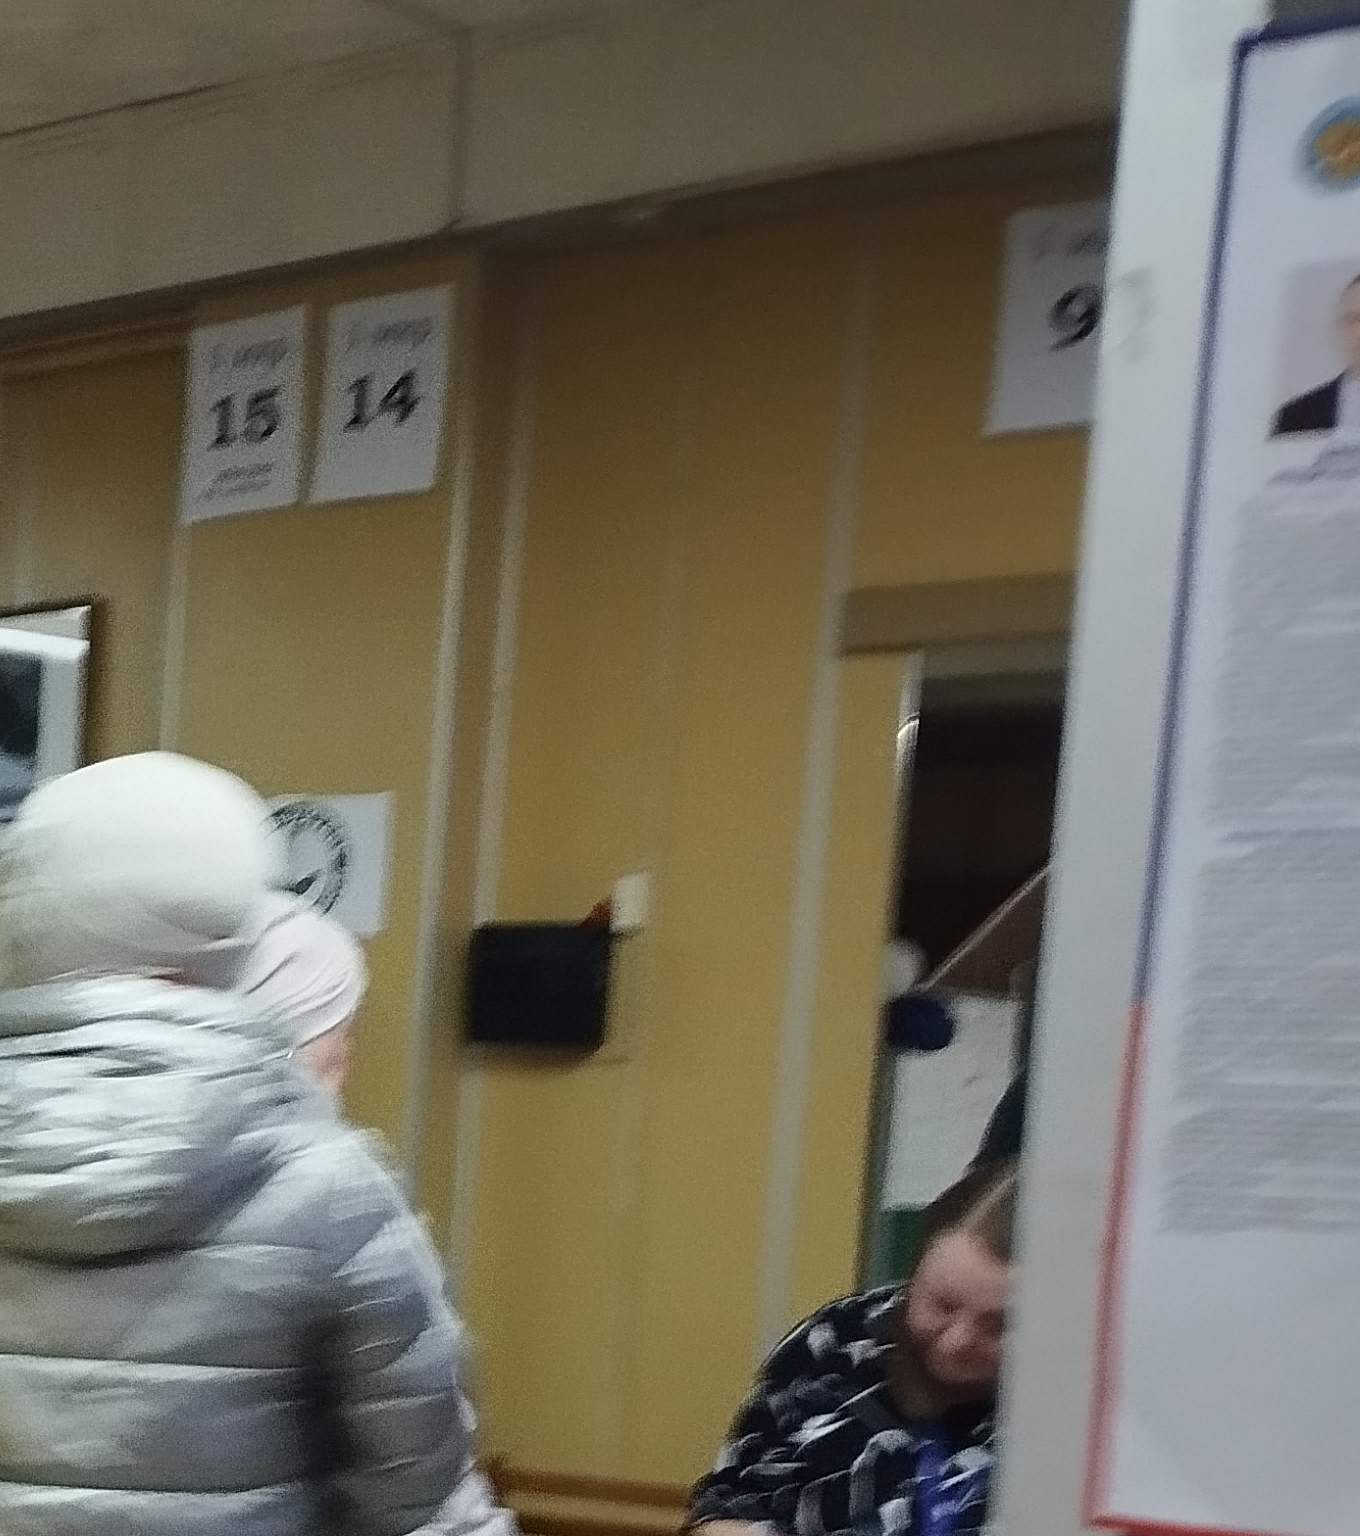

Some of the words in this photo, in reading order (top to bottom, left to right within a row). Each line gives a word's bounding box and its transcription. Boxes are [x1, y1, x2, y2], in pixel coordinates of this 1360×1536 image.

[1047, 283, 1104, 353] 9
[207, 386, 283, 451] 15
[344, 367, 421, 434] 14
